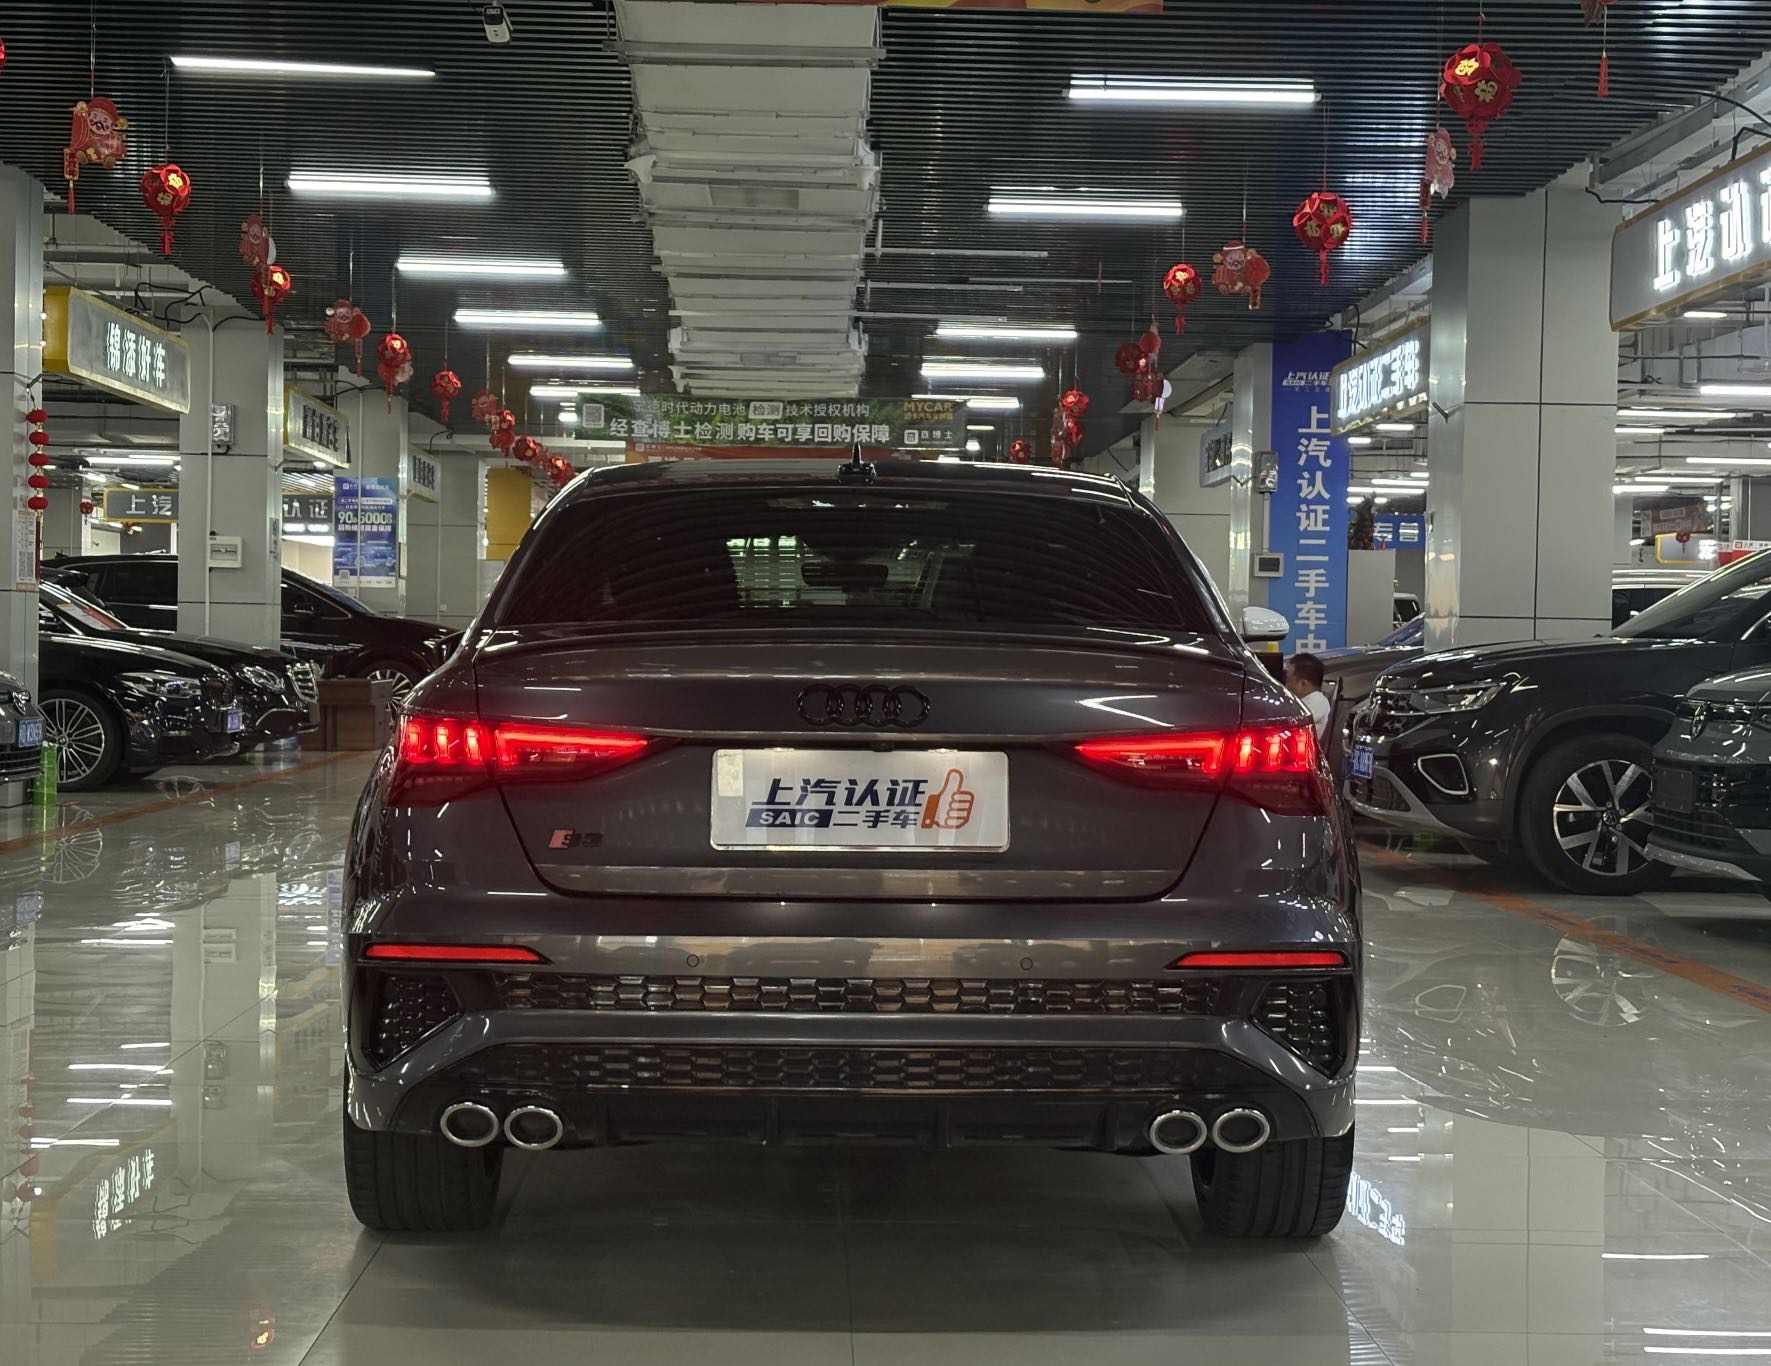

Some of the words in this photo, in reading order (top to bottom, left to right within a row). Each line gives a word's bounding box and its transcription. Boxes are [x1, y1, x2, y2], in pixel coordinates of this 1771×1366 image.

[1285, 371, 1331, 381] 上汽认证
[904, 402, 953, 412] MYCAR
[125, 494, 172, 515] 上汽
[752, 778, 928, 806] 上汽认证
[759, 811, 821, 825] SAIC
[833, 809, 920, 828] 二手车
